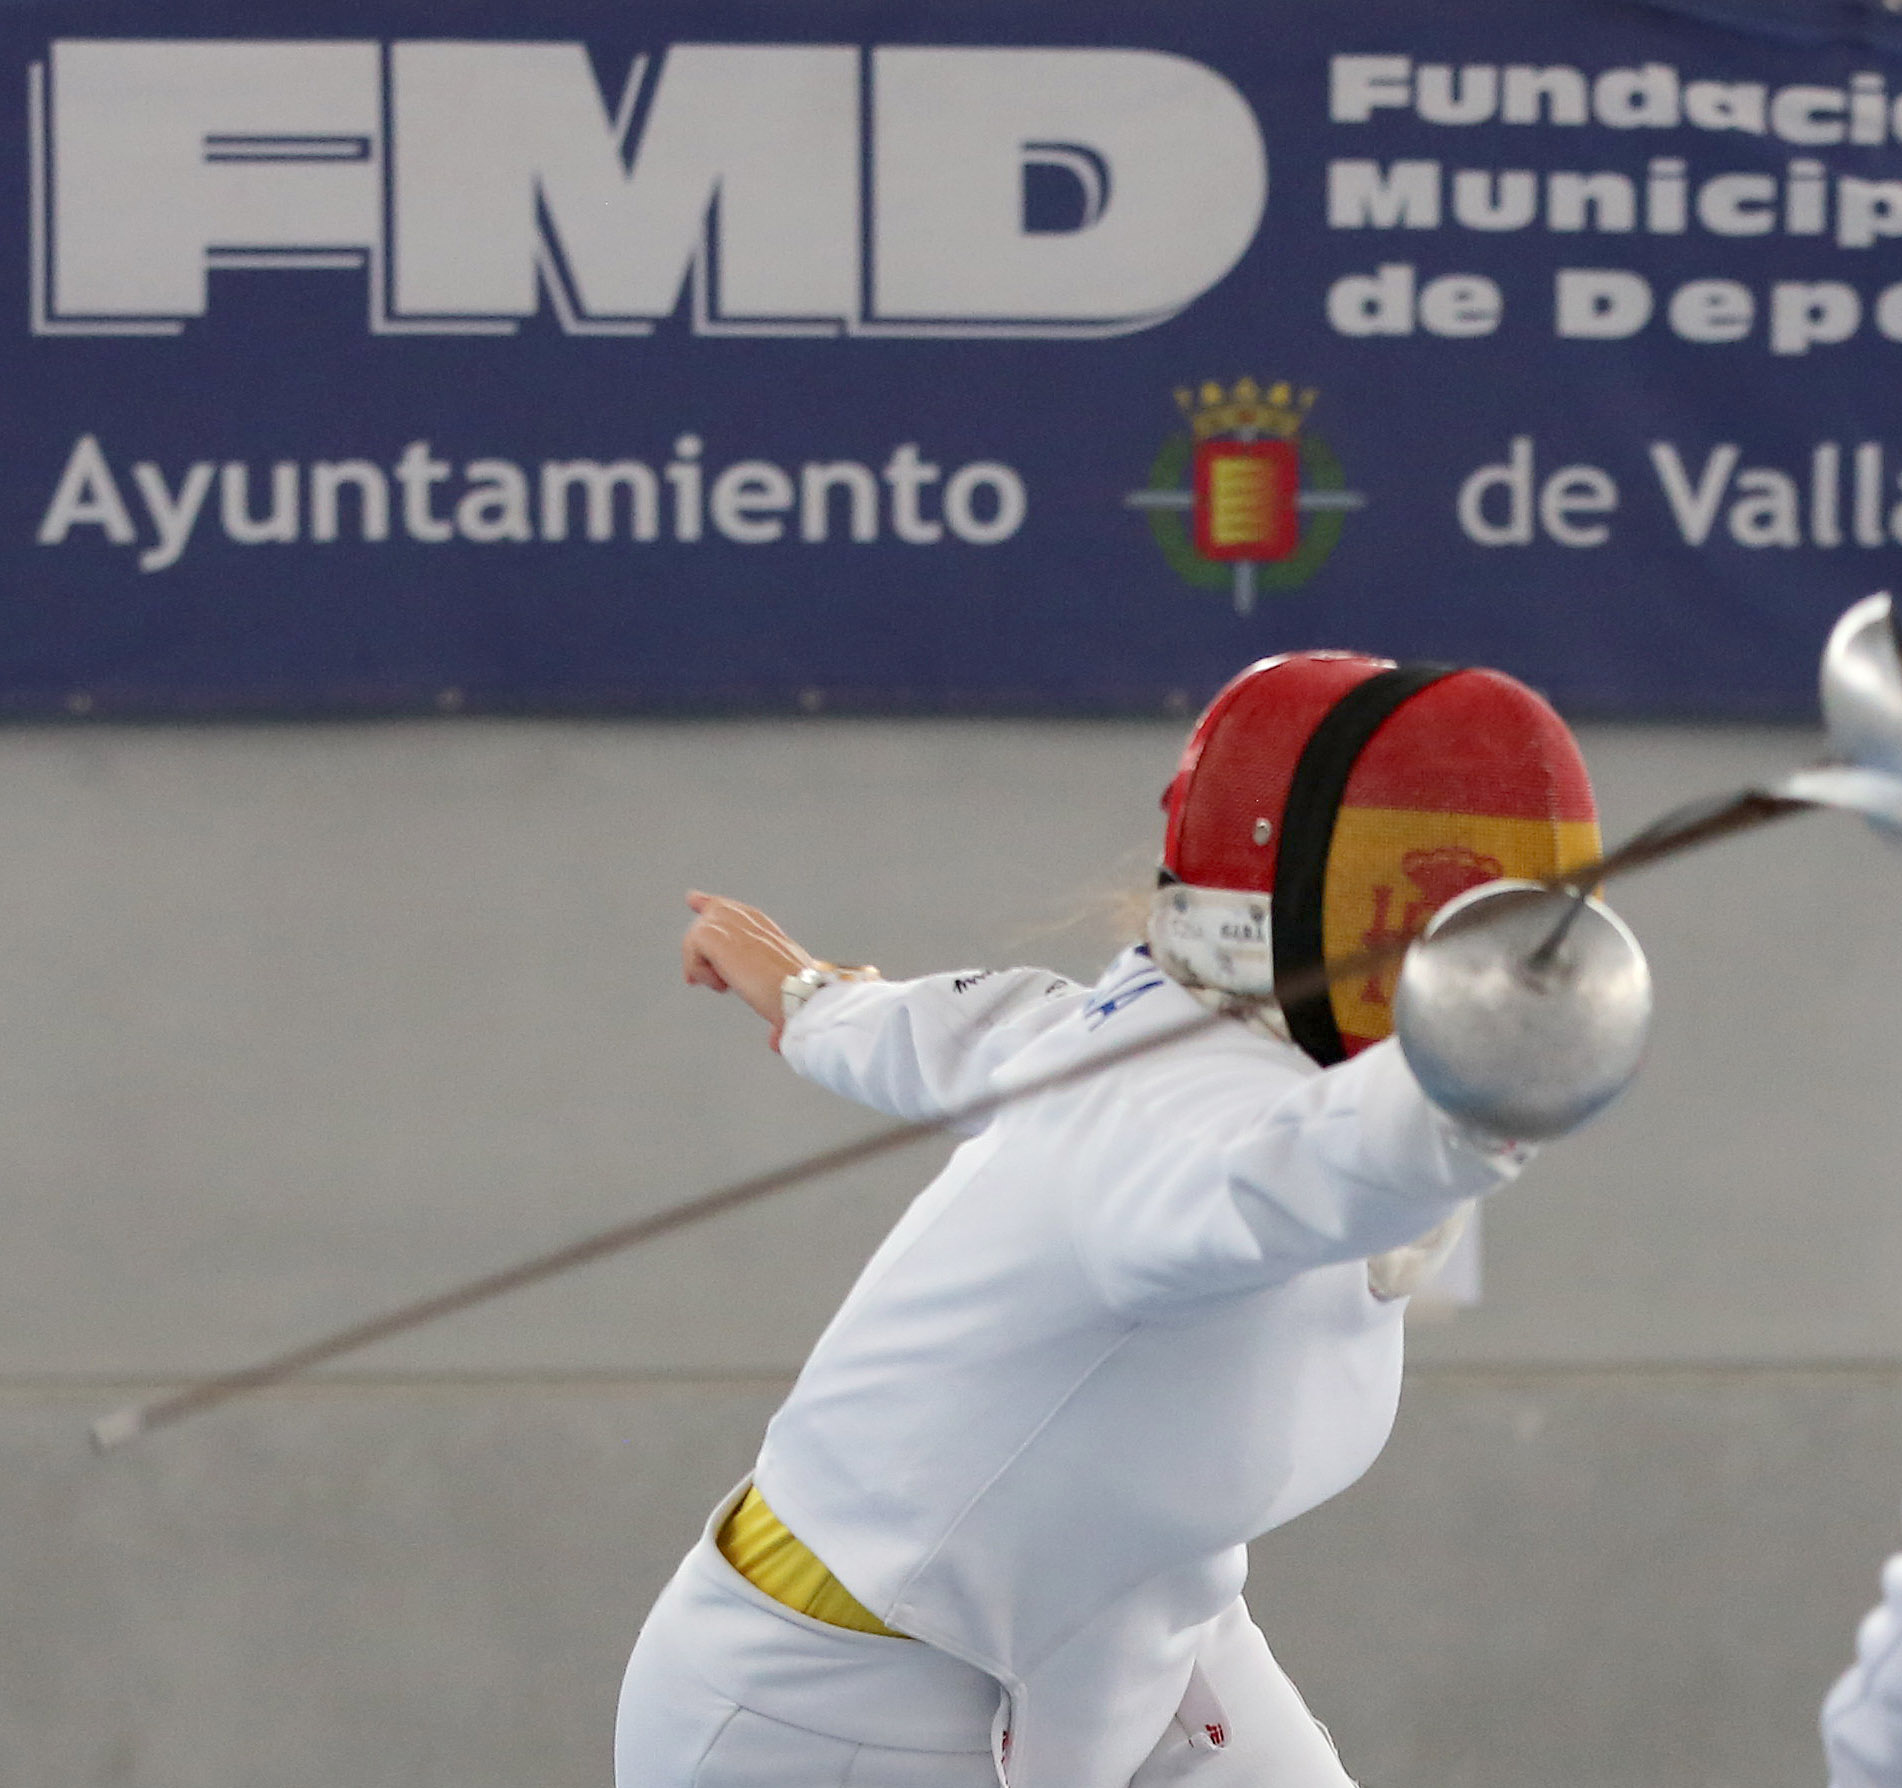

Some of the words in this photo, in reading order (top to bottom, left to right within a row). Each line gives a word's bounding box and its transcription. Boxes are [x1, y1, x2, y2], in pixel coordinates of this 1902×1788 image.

[29, 39, 1268, 338] FMD
[1327, 264, 1502, 338] de
[38, 436, 1026, 572] Ayuntamiento
[1458, 437, 1618, 546] de
